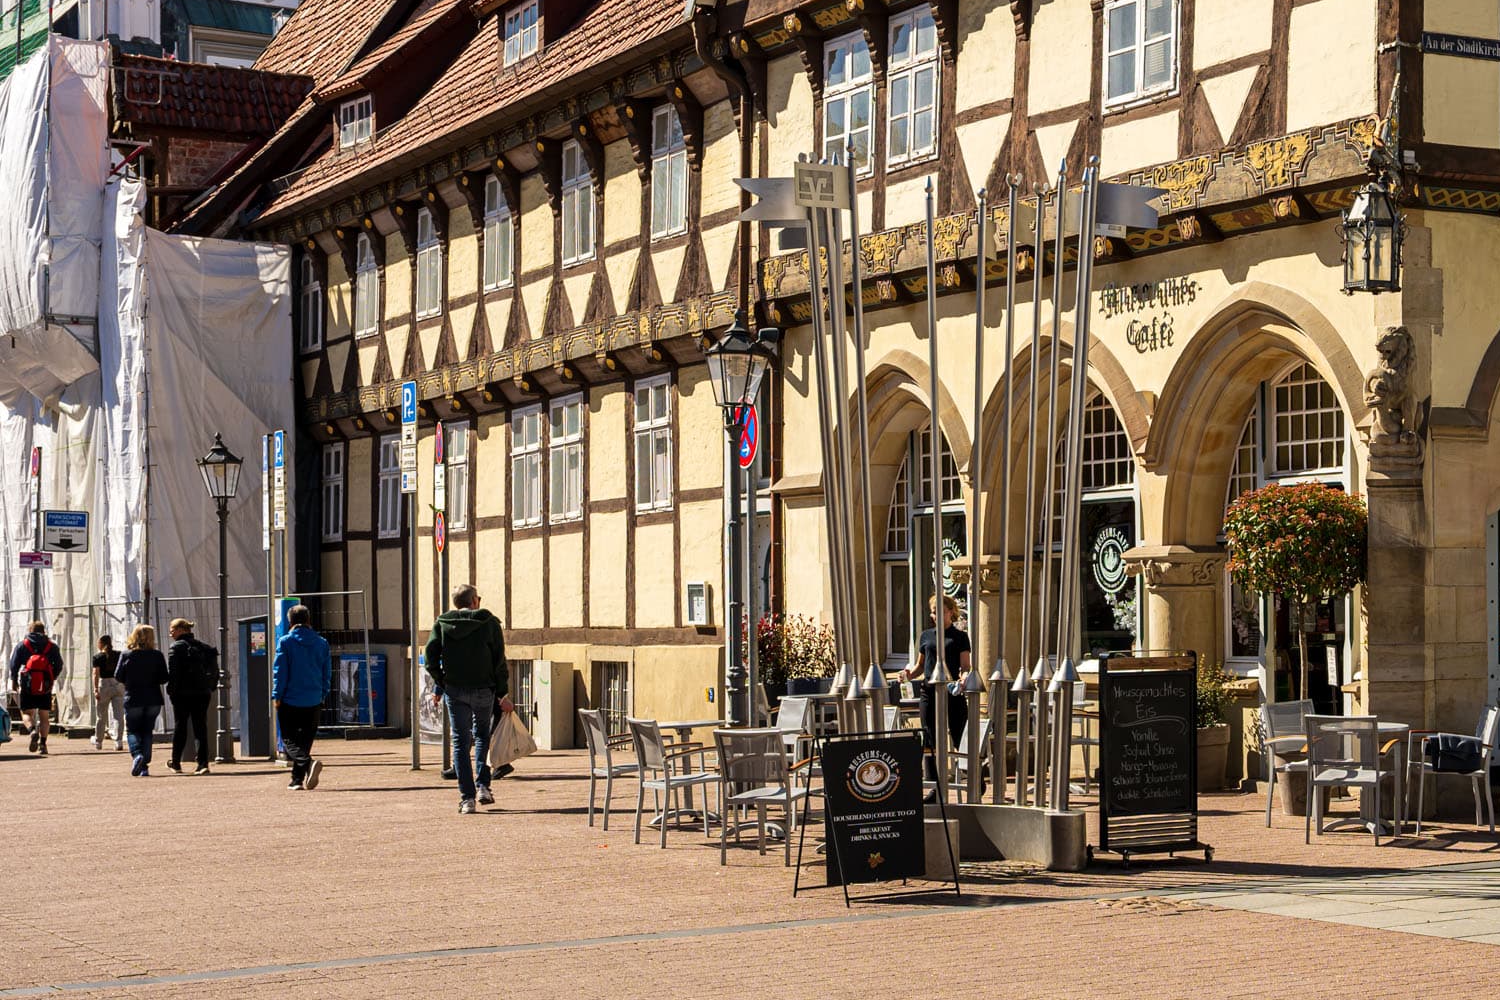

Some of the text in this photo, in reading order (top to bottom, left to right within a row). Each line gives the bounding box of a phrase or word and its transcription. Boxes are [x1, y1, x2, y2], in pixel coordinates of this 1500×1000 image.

[1425, 35, 1438, 49] An
[1440, 37, 1455, 51] der
[403, 387, 412, 419] P
[1135, 703, 1157, 719] Eis
[851, 834, 872, 842] DRINKS
[878, 831, 900, 839] SNACKS
[859, 825, 891, 834] BREAKFAST
